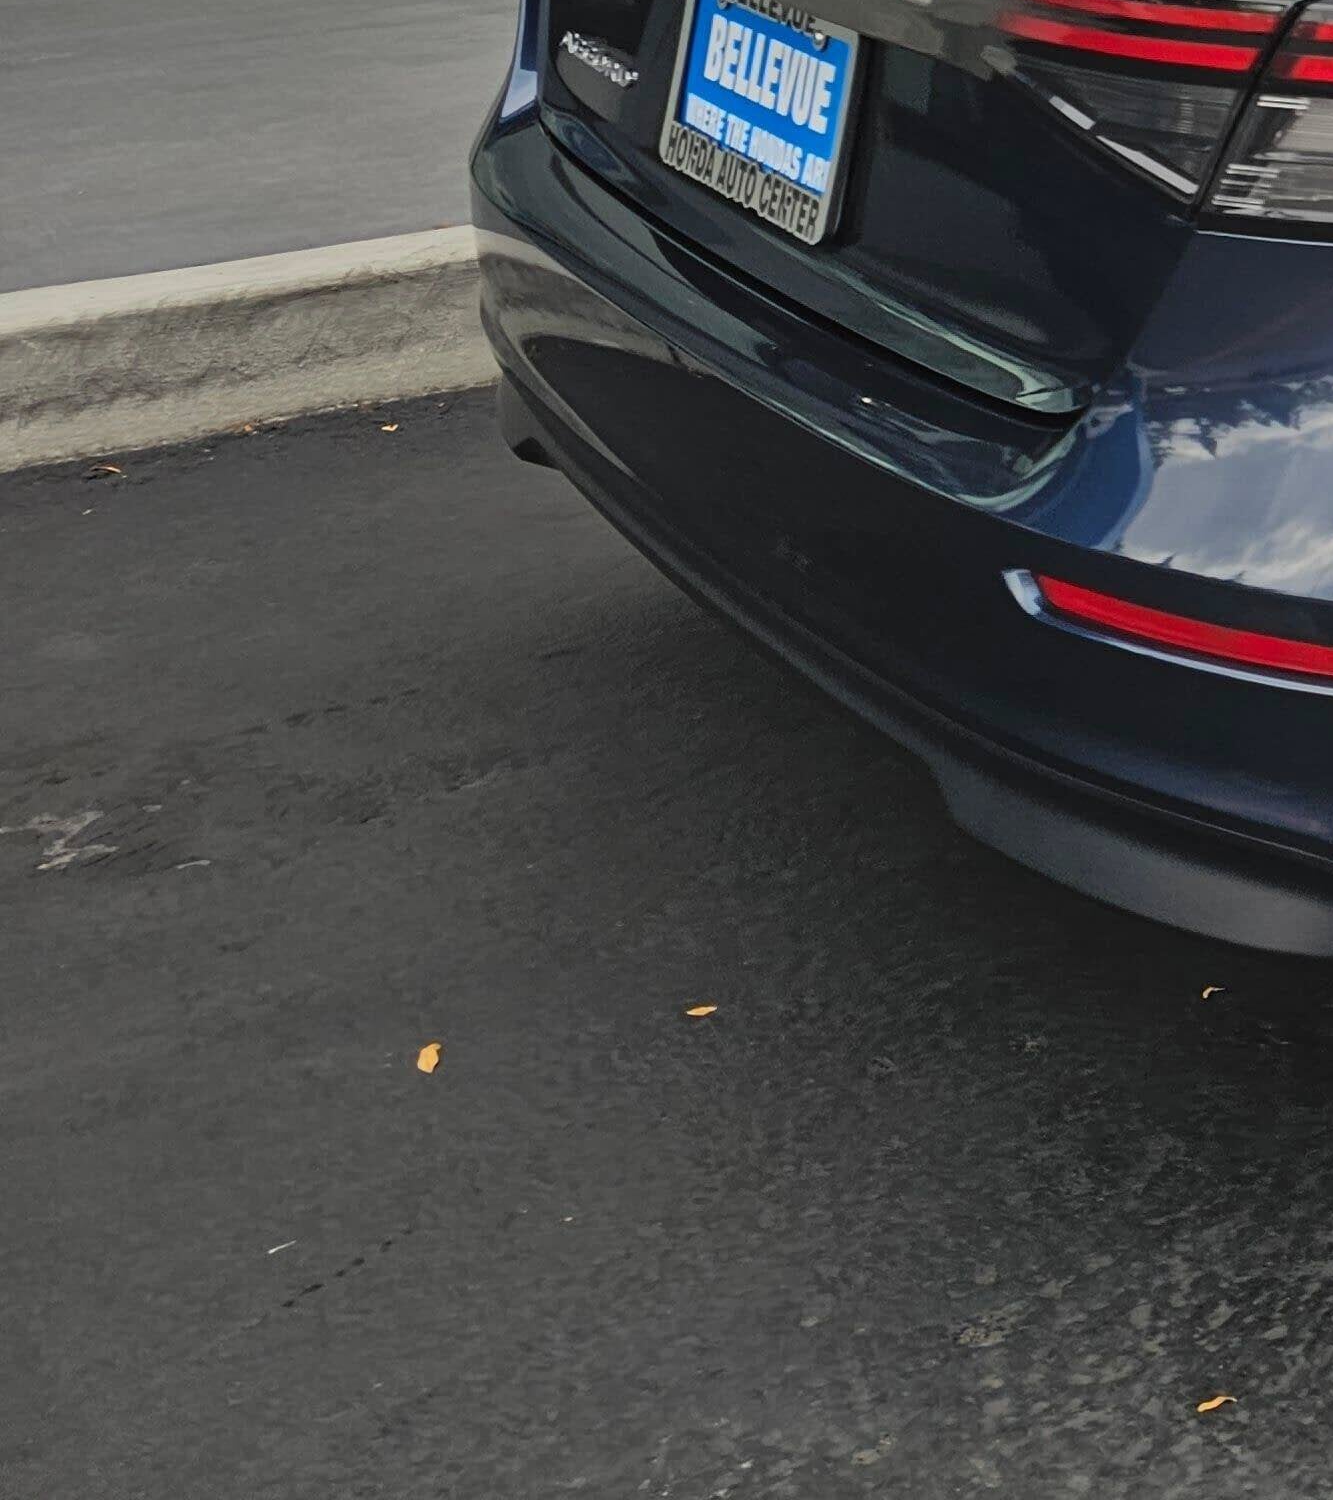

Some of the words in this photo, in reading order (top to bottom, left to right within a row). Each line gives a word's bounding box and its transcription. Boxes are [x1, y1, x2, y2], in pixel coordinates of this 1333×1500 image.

[704, 13, 836, 134] BELLEVUE
[665, 122, 718, 181] HONDA
[716, 145, 758, 206] AUTO
[758, 172, 821, 240] CENTER
[725, 113, 751, 153] THE
